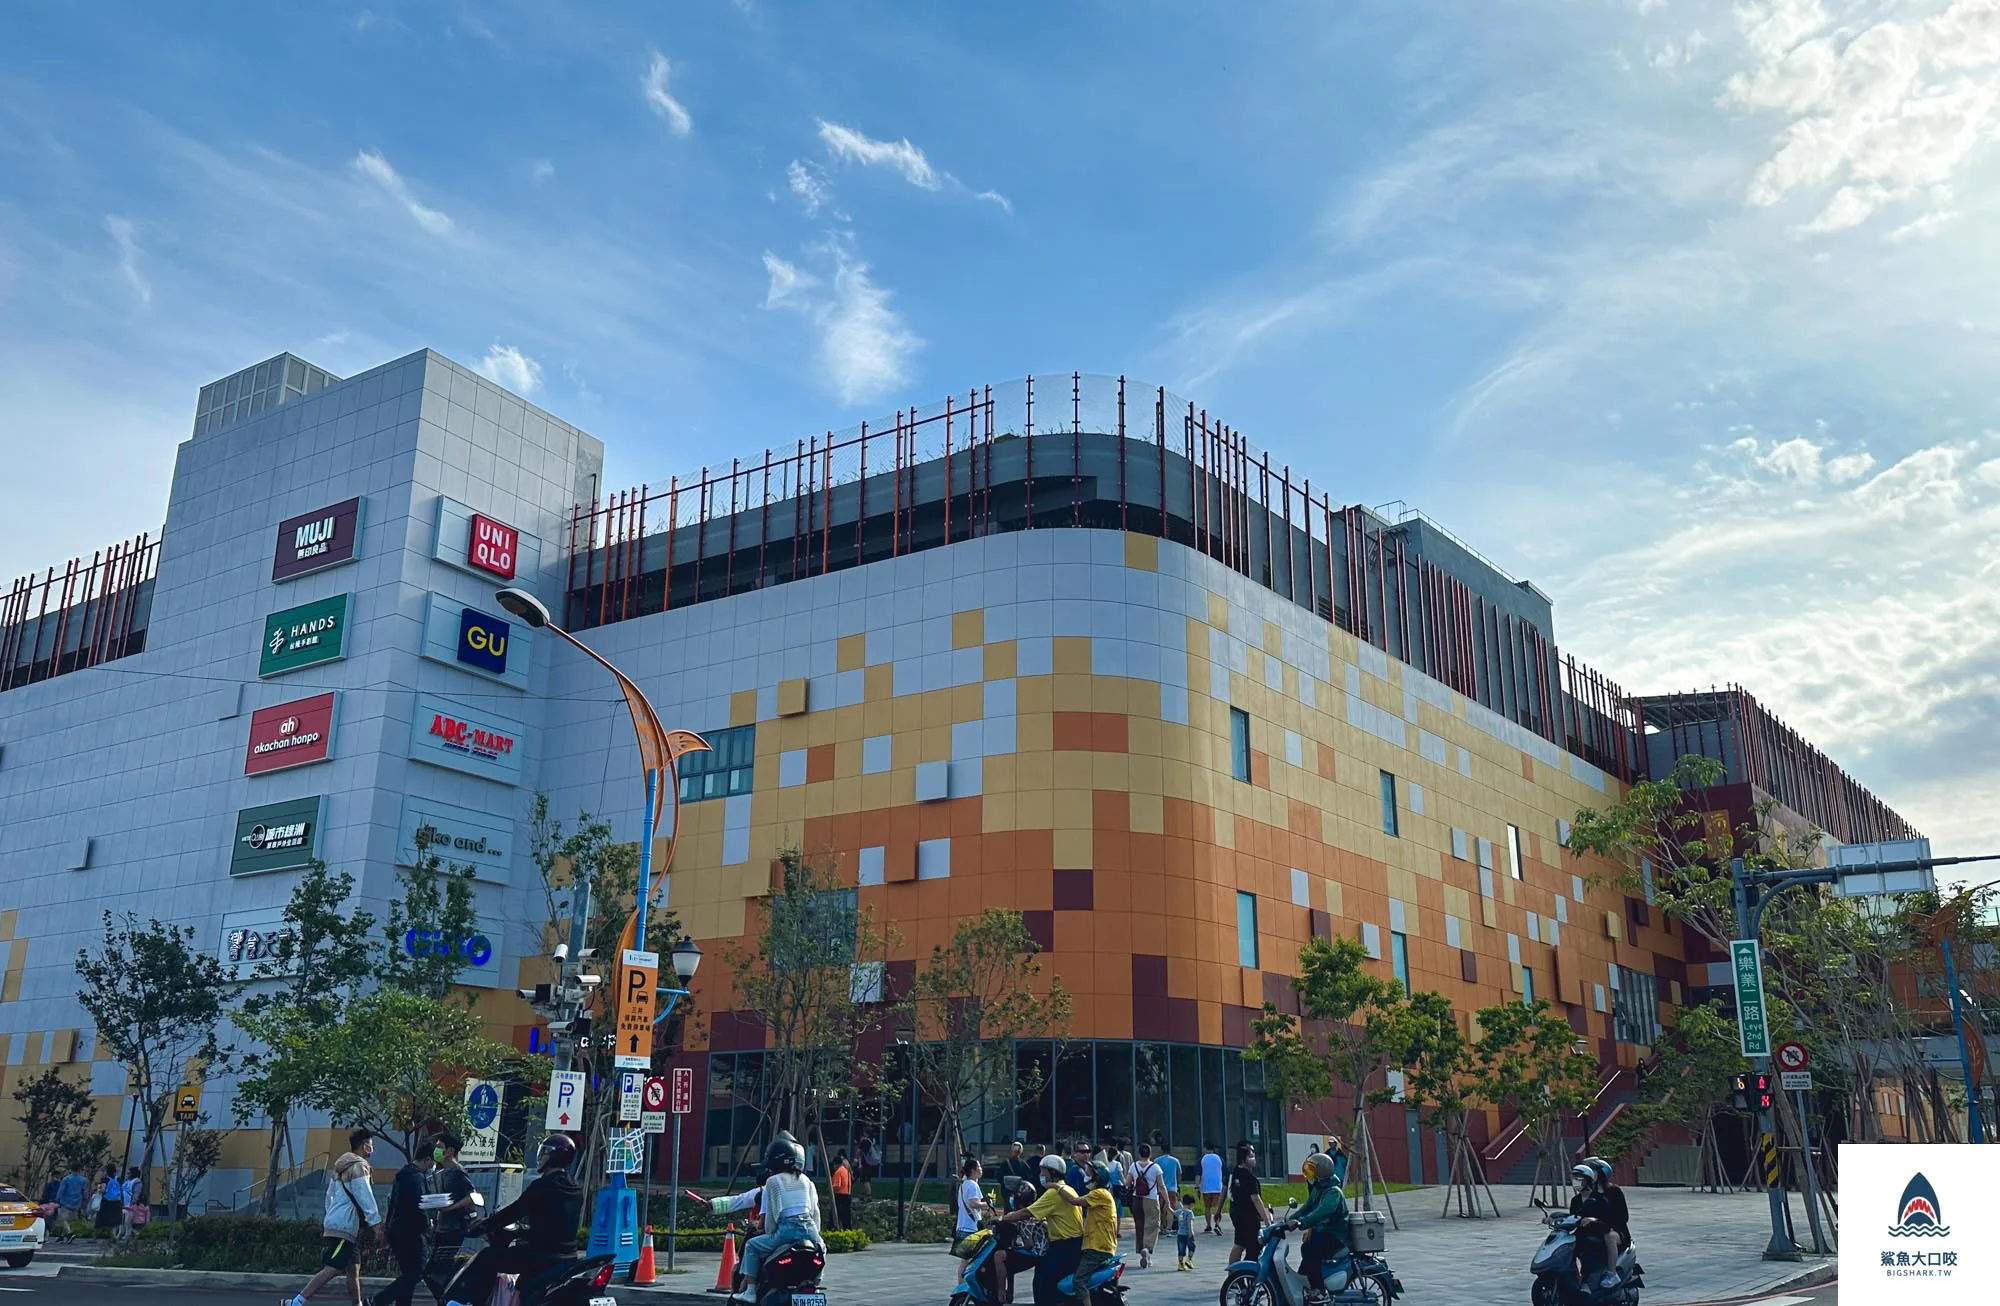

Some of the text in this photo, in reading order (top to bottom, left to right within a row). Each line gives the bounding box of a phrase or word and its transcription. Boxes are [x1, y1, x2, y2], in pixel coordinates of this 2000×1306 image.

[295, 517, 334, 549] MUJI
[479, 522, 510, 550] UNI
[477, 543, 511, 570] QLO
[290, 616, 334, 638] HANDS
[467, 626, 505, 656] GU
[281, 717, 295, 734] ah
[428, 714, 513, 753] ABC-MART
[254, 732, 319, 754] akachan honpo
[454, 836, 487, 854] and
[628, 970, 646, 1003] P
[1743, 1022, 1763, 1032] Leye
[1746, 1032, 1762, 1040] 2nd
[180, 1112, 194, 1120] TAXI
